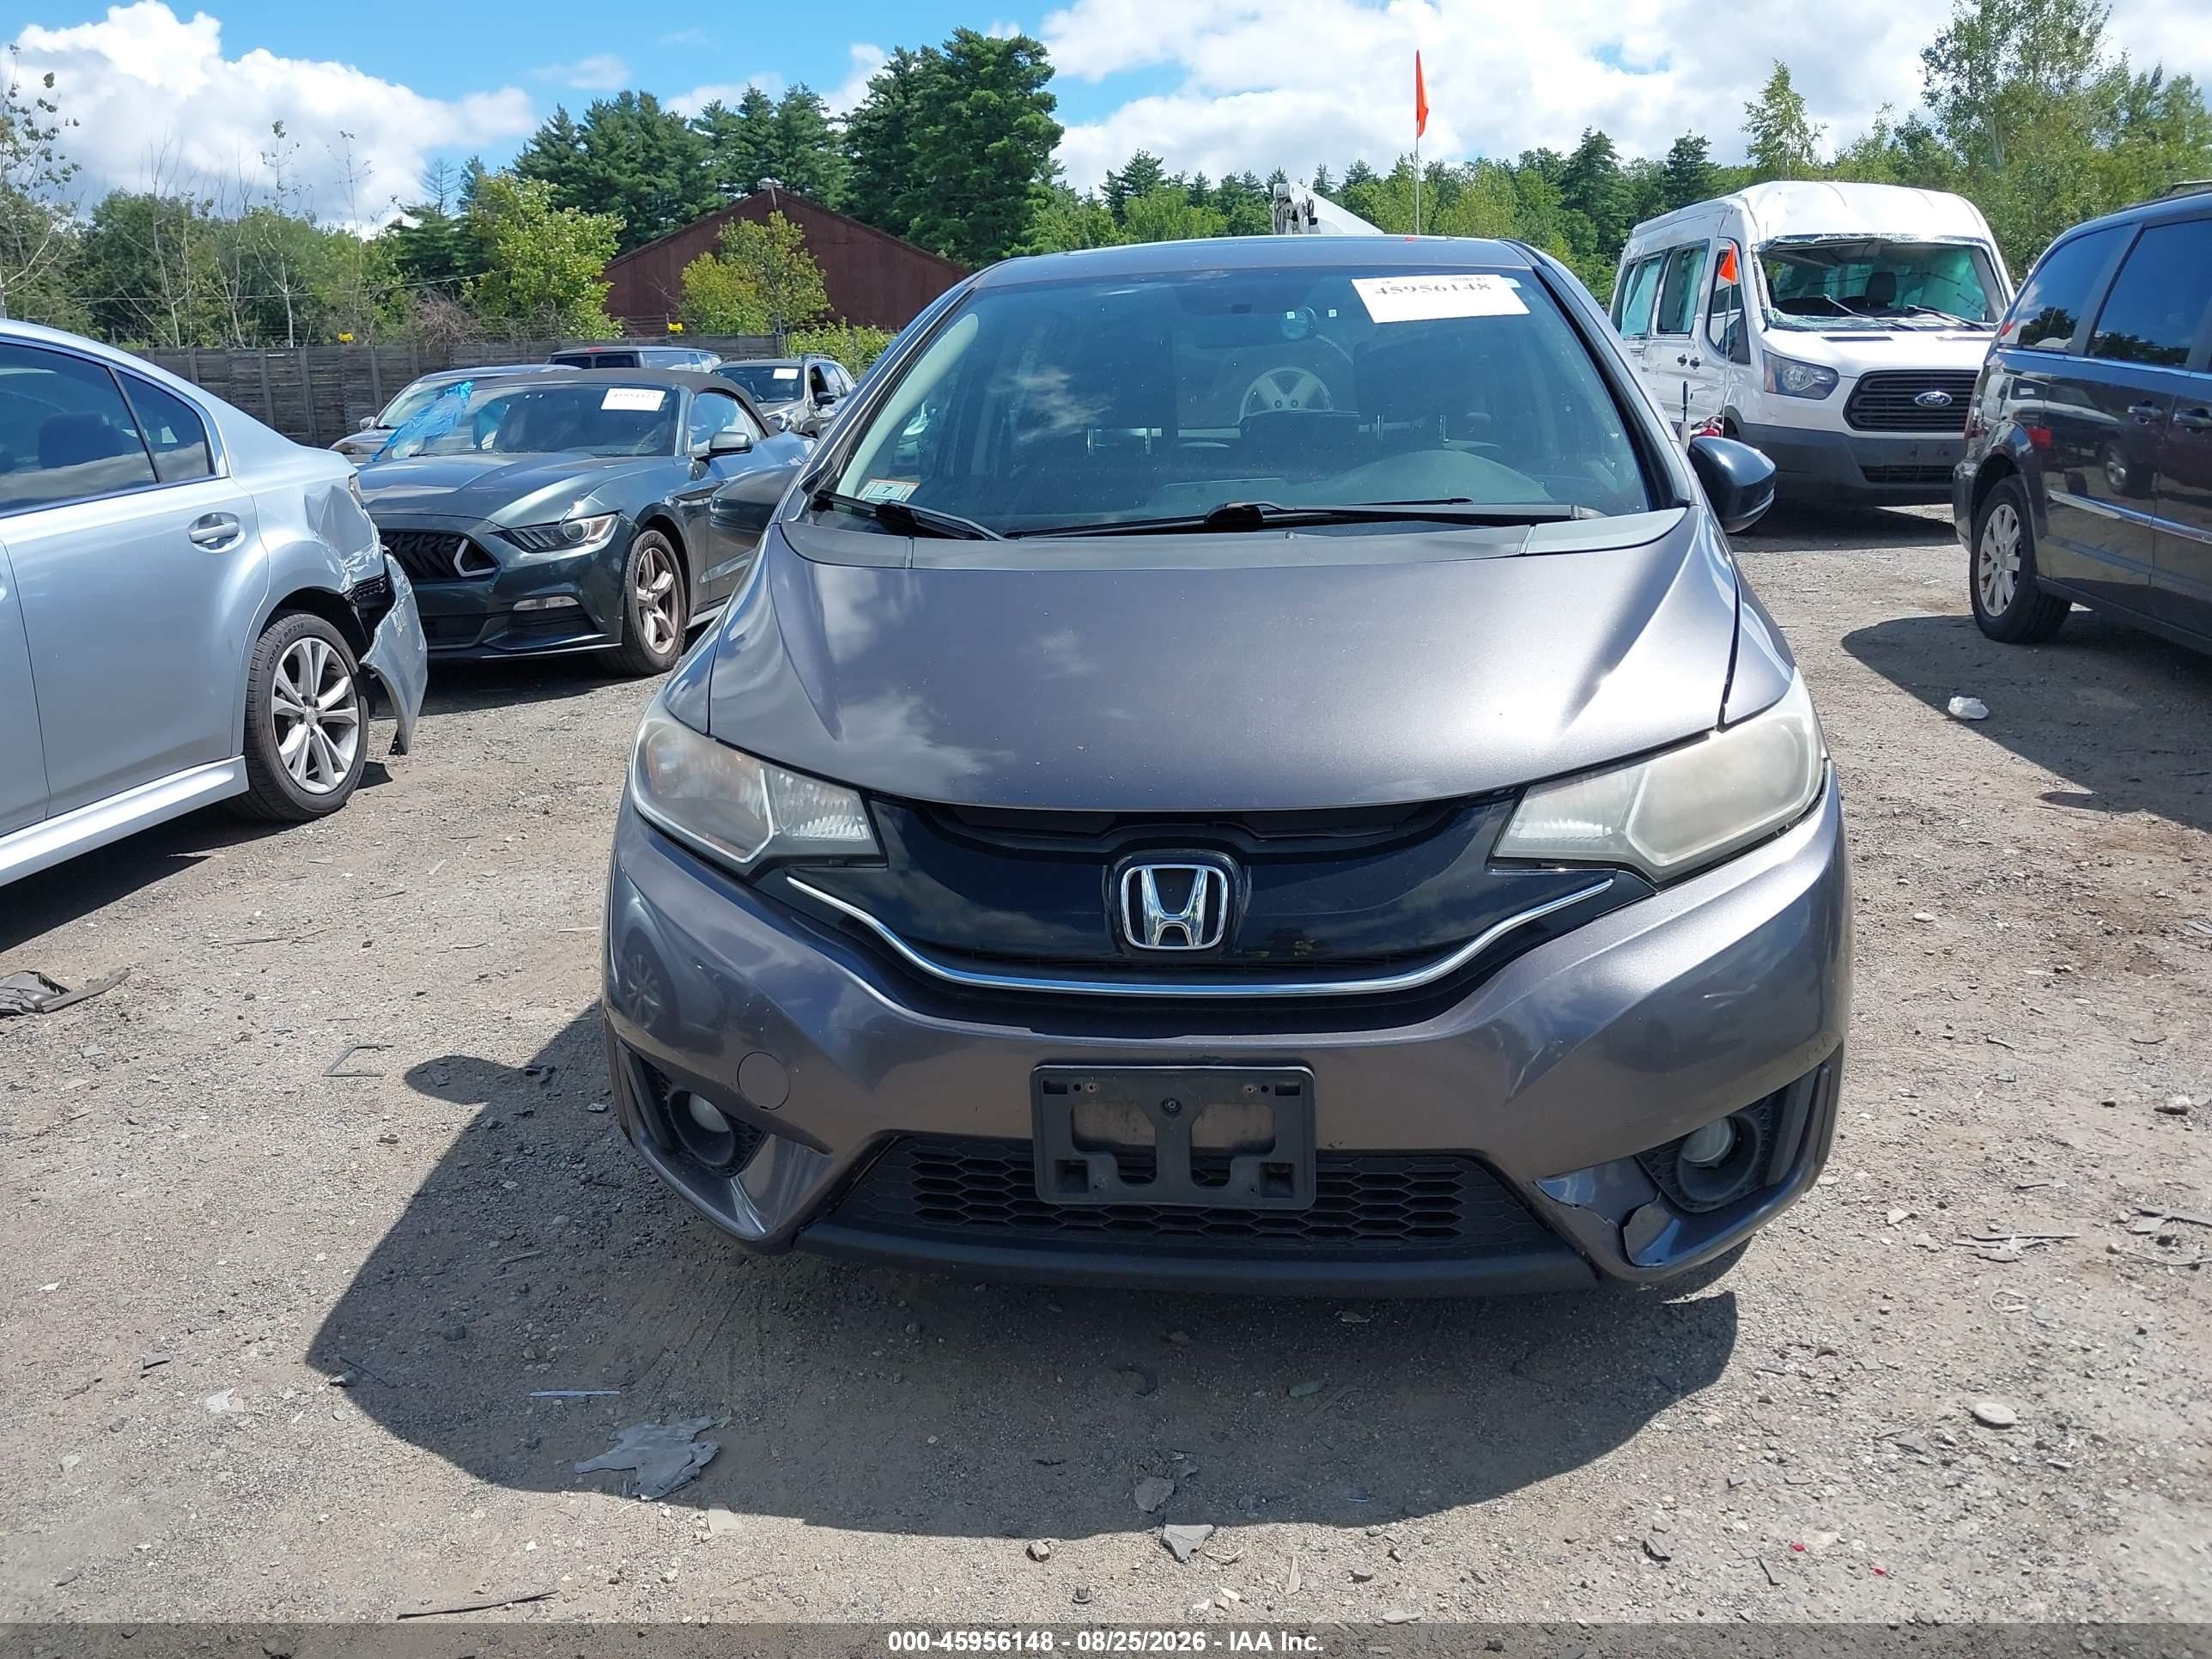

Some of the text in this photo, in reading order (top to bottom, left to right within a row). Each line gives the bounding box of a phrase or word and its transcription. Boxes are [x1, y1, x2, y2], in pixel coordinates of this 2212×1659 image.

[1375, 283, 1492, 295] 45956148
[882, 486, 894, 495] 7
[266, 623, 304, 671] FORAY RP210
